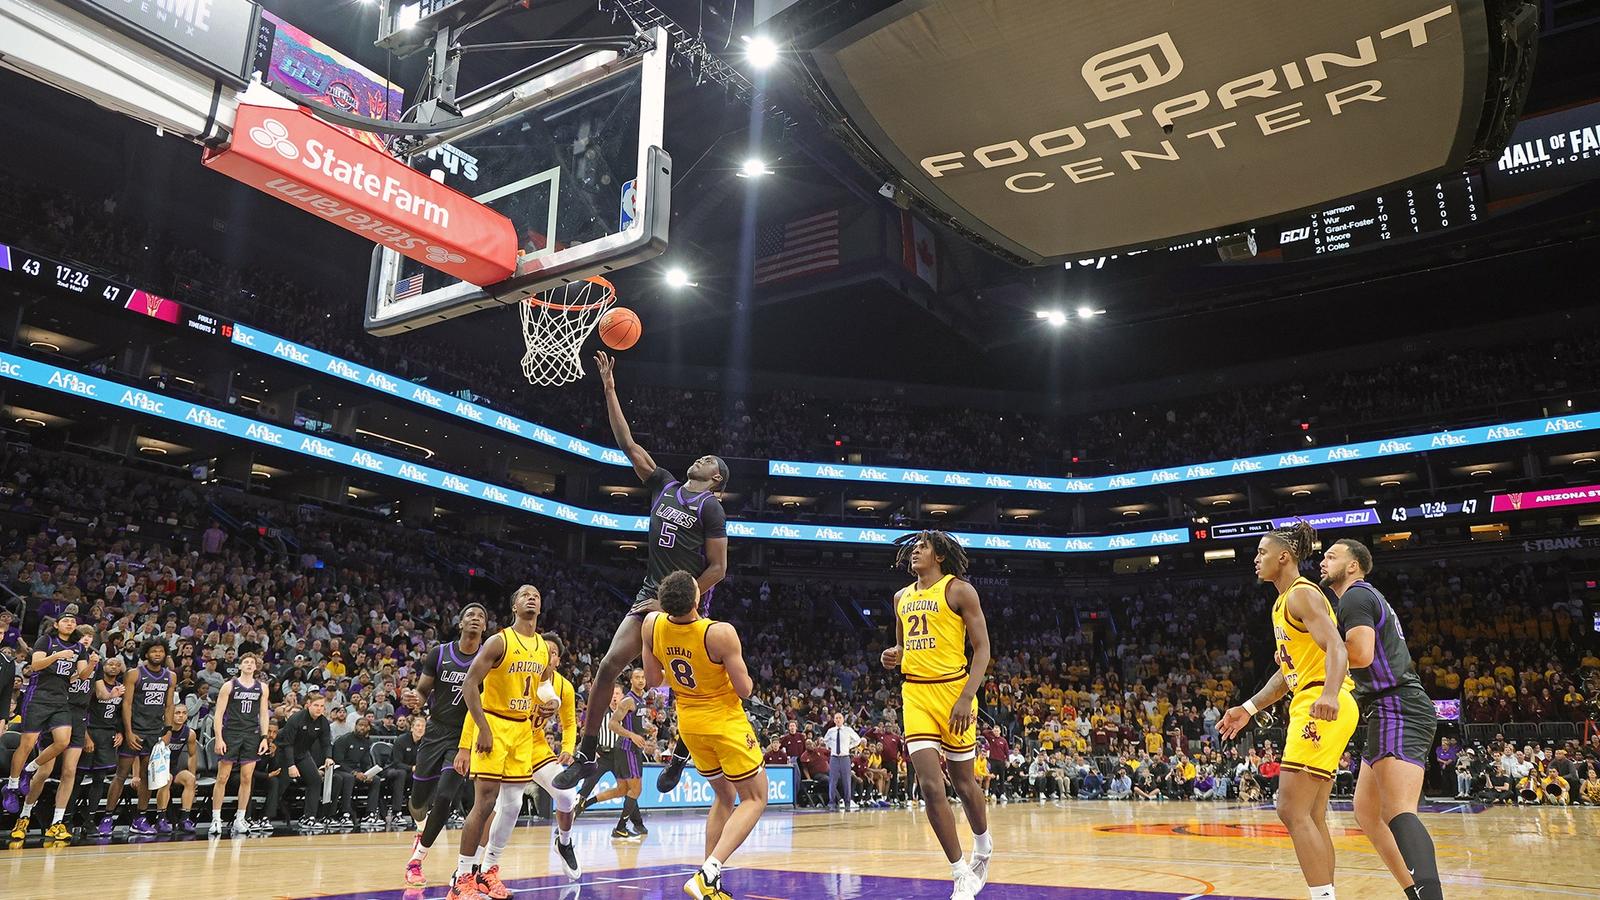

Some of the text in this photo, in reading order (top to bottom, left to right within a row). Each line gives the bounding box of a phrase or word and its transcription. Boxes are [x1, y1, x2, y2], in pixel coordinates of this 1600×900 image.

[921, 5, 1453, 178] FOOTPRINT
[1005, 80, 1387, 193] CENTER
[1498, 139, 1550, 170] HALL
[1550, 134, 1566, 150] OF
[1407, 190, 1412, 198] 3
[1312, 220, 1318, 228] 5
[1314, 228, 1319, 236] 7
[1378, 214, 1388, 222] 10
[1326, 232, 1350, 243] Moore
[1470, 204, 1475, 212] 3
[1280, 226, 1310, 244] GCU
[1316, 246, 1326, 254] 21
[1328, 242, 1350, 252] Coles
[1380, 232, 1390, 240] 12
[22, 259, 120, 301] 43 17:26 47
[222, 325, 232, 337] 15
[274, 341, 309, 364] Aflac
[327, 359, 359, 380] Aflac
[366, 373, 397, 393] Aflac
[412, 388, 441, 407] Aflac
[455, 402, 482, 421] Aflac
[495, 415, 521, 433] Aflac
[533, 428, 556, 445] Aflac
[568, 439, 590, 455] Aflac
[48, 371, 95, 395] Aflac
[120, 390, 164, 413] Aflac
[186, 407, 225, 429] Aflac
[246, 423, 282, 444] Aflac
[300, 437, 334, 458] Aflac
[351, 451, 383, 470] Aflac
[398, 464, 427, 482] Aflac
[441, 475, 469, 493] Aflac
[483, 486, 508, 503] Aflac
[520, 496, 544, 512] Aflac
[555, 506, 578, 521] Aflac
[591, 514, 618, 527] Aflac
[772, 419, 1581, 491] Aflac Aflac Aflac Aflac Aflac Aflac Aflac Aflac Aflac Aflac Aflac Aflac Aflac Aflac Aflac Aflac Aflac Aflac
[1536, 492, 1587, 502] ARIZONA
[656, 504, 698, 528] LOPES
[1310, 516, 1343, 525] CANYON
[1344, 512, 1370, 524] GCU
[1392, 500, 1476, 521] 43 17:26 47
[658, 522, 678, 548] 5
[726, 523, 886, 542] Aflac Aflac Aflac Aflac
[984, 536, 1011, 548] Aflac
[1025, 538, 1051, 550] Aflac
[1065, 539, 1093, 550] Aflac
[1108, 536, 1136, 547] Aflac
[1151, 532, 1179, 543] Aflac
[1195, 530, 1206, 540] 15
[902, 600, 939, 616] ARIZONA
[908, 614, 928, 636] 21
[666, 646, 692, 658] JIHAD
[906, 638, 936, 650] STATE
[56, 660, 72, 676] 12
[440, 670, 467, 684] LOP
[508, 661, 544, 675] ARIZON
[670, 658, 698, 690] 8
[68, 679, 90, 694] 34
[523, 676, 531, 696] 1
[144, 692, 165, 705] 23
[452, 686, 464, 706] 7
[510, 698, 531, 710] STA
[104, 704, 116, 718] 2
[240, 700, 252, 714] 11
